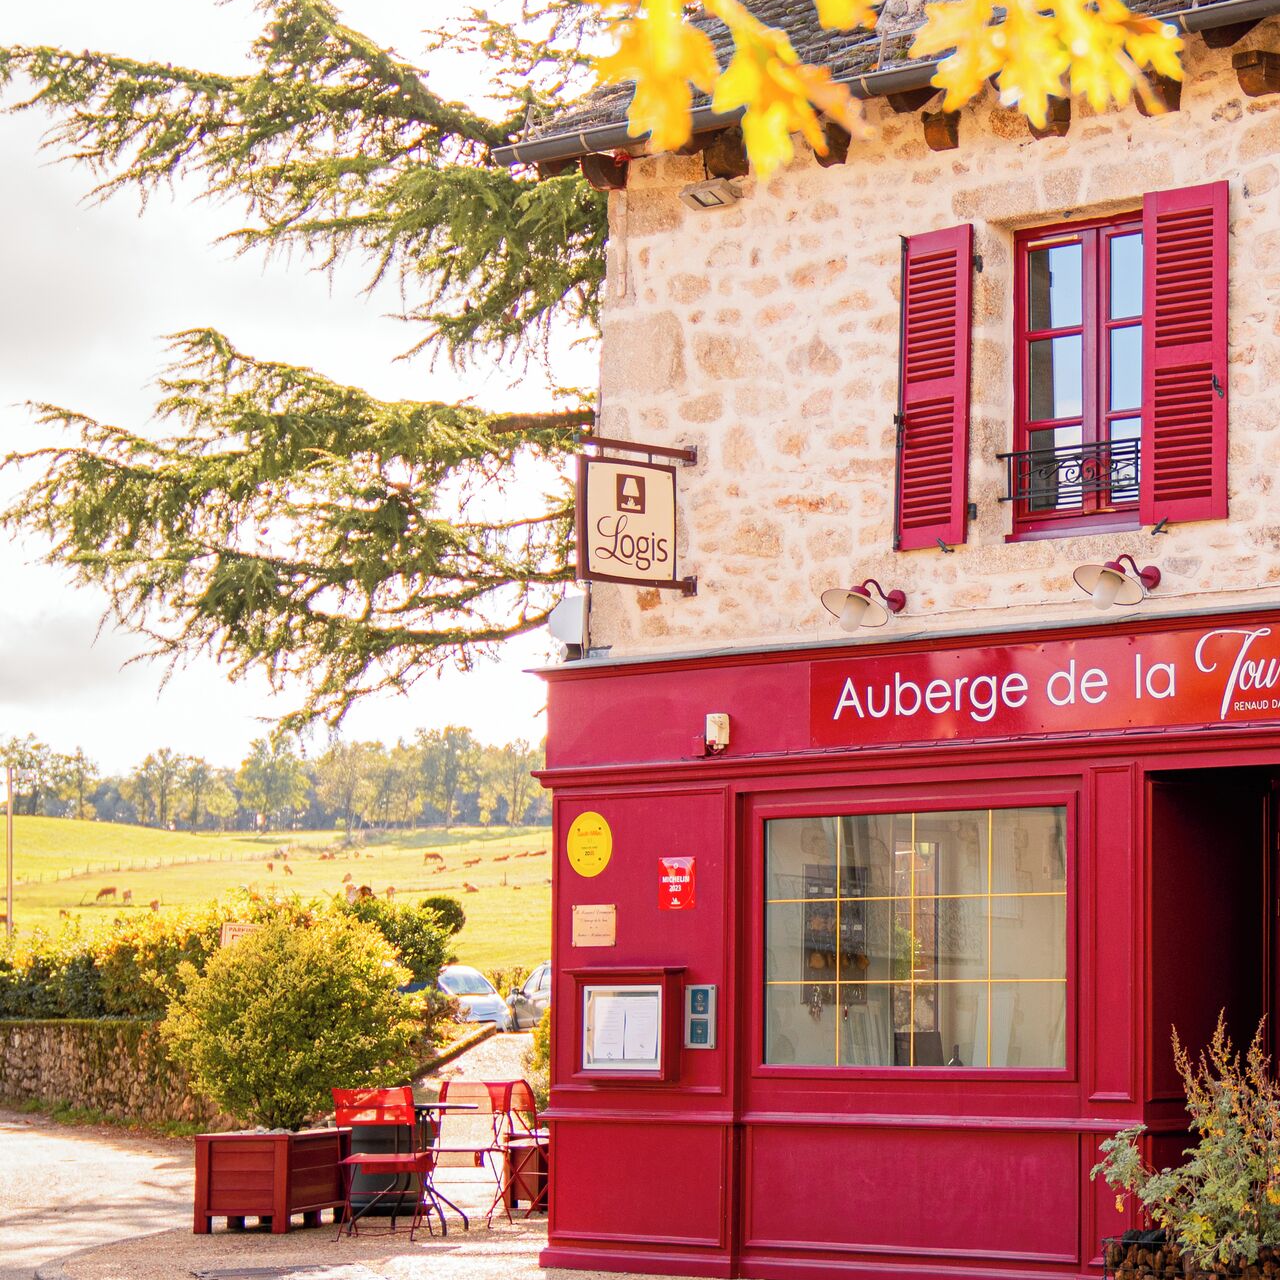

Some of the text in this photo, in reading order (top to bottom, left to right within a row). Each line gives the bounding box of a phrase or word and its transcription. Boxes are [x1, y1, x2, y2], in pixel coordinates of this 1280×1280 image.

[595, 514, 668, 571] Logis
[833, 672, 1029, 722] Auberge
[1046, 659, 1109, 706] de
[1134, 653, 1176, 700] la
[1233, 699, 1269, 711] RENAUD
[662, 875, 690, 883] MICHELIN
